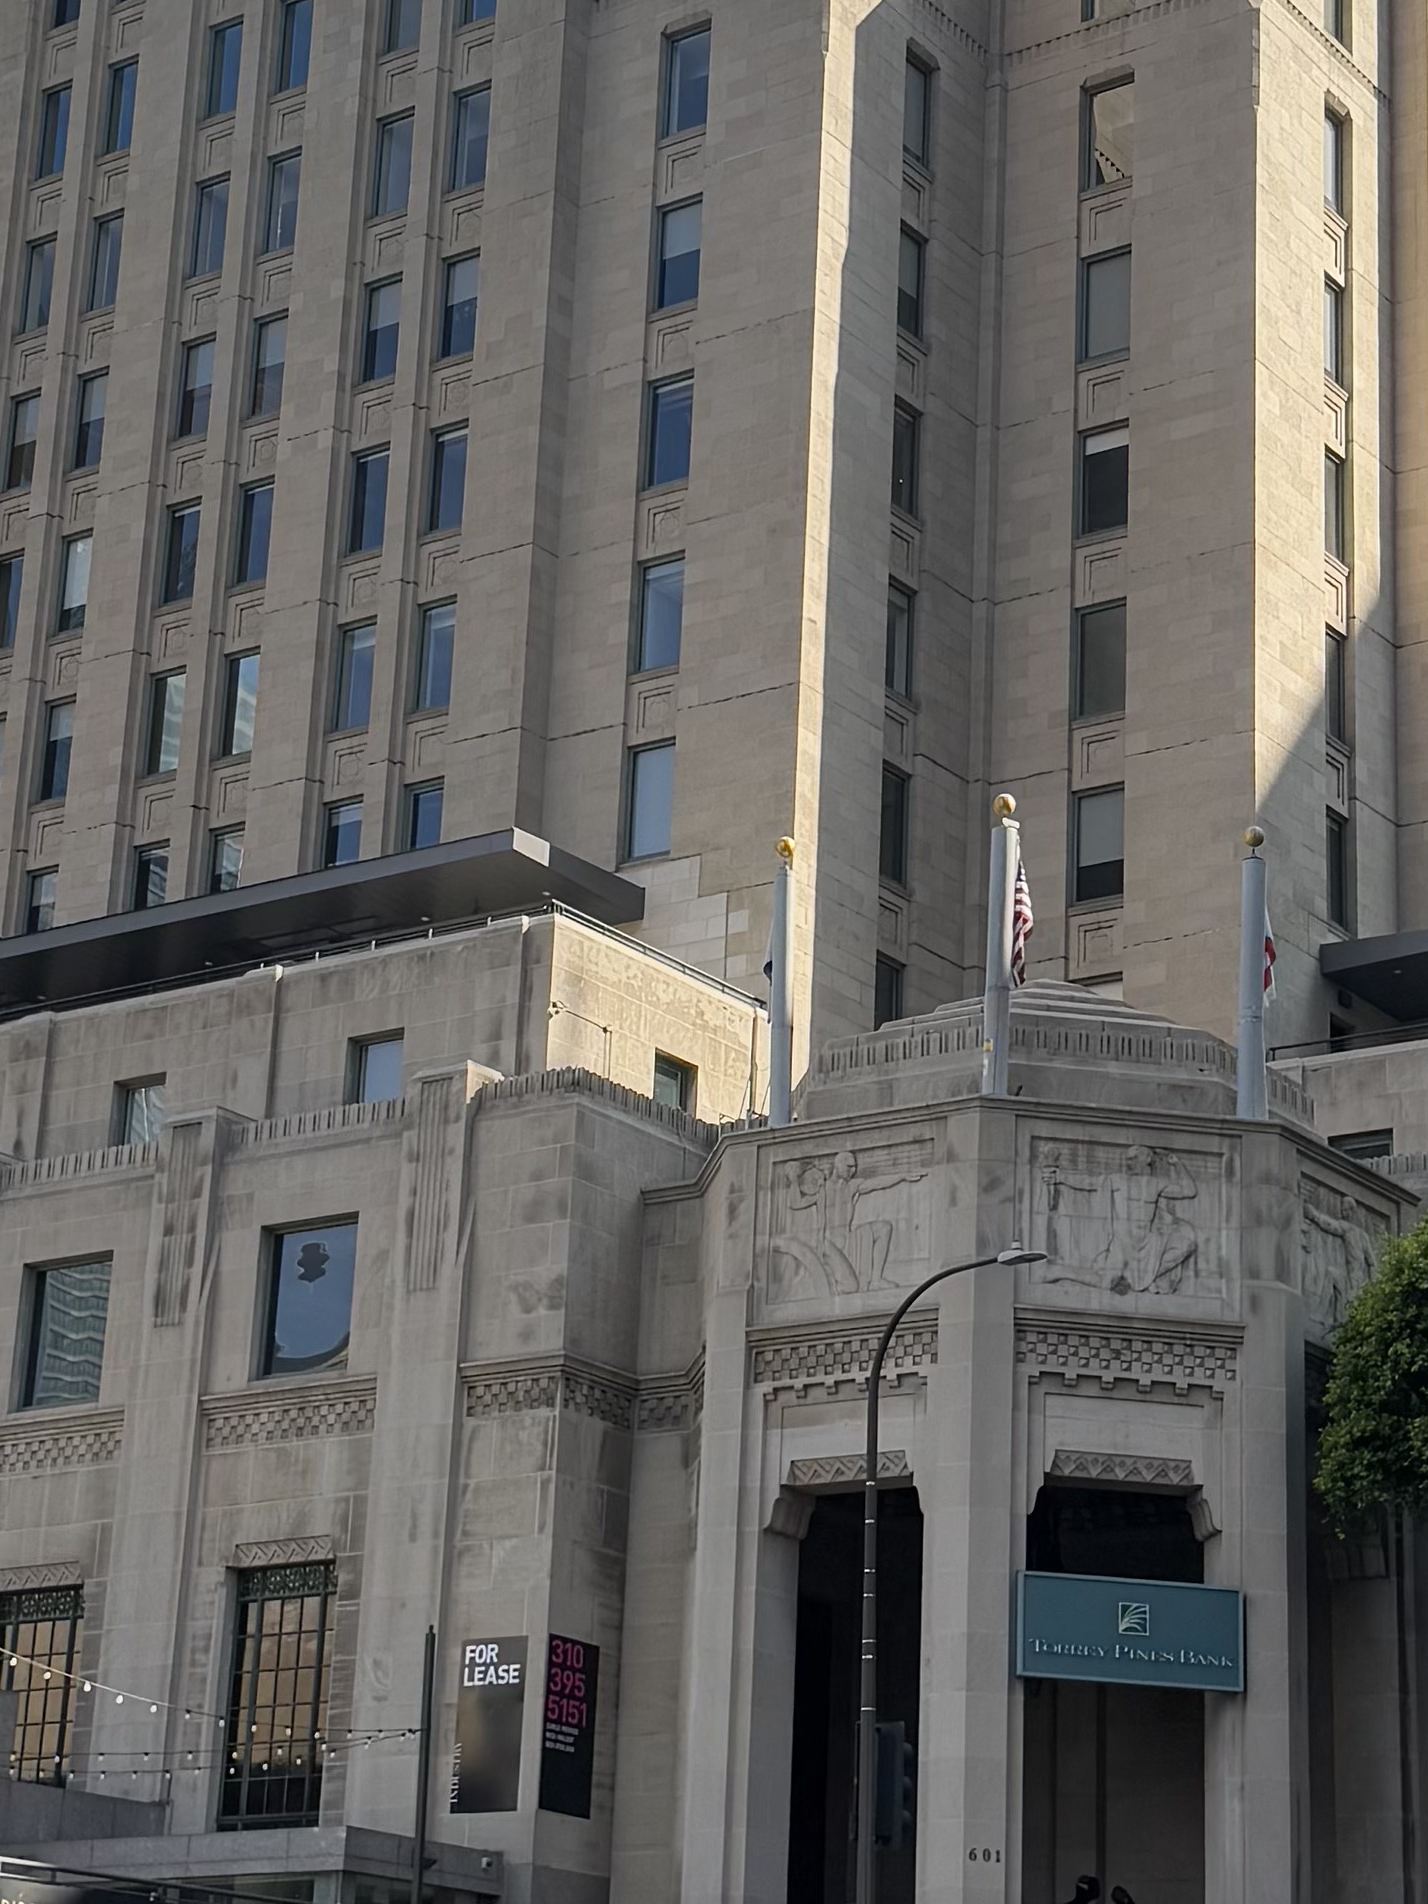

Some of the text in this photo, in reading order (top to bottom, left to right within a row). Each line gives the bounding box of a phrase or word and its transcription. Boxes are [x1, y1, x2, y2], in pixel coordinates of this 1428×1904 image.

[465, 1644, 499, 1665] FOR
[551, 1640, 584, 1669] 310
[1028, 1638, 1234, 1667] TORREY PINES BANK
[463, 1664, 521, 1687] LEASE
[549, 1669, 586, 1698] 395
[547, 1695, 587, 1728] 5151
[968, 1847, 1001, 1863] 601
